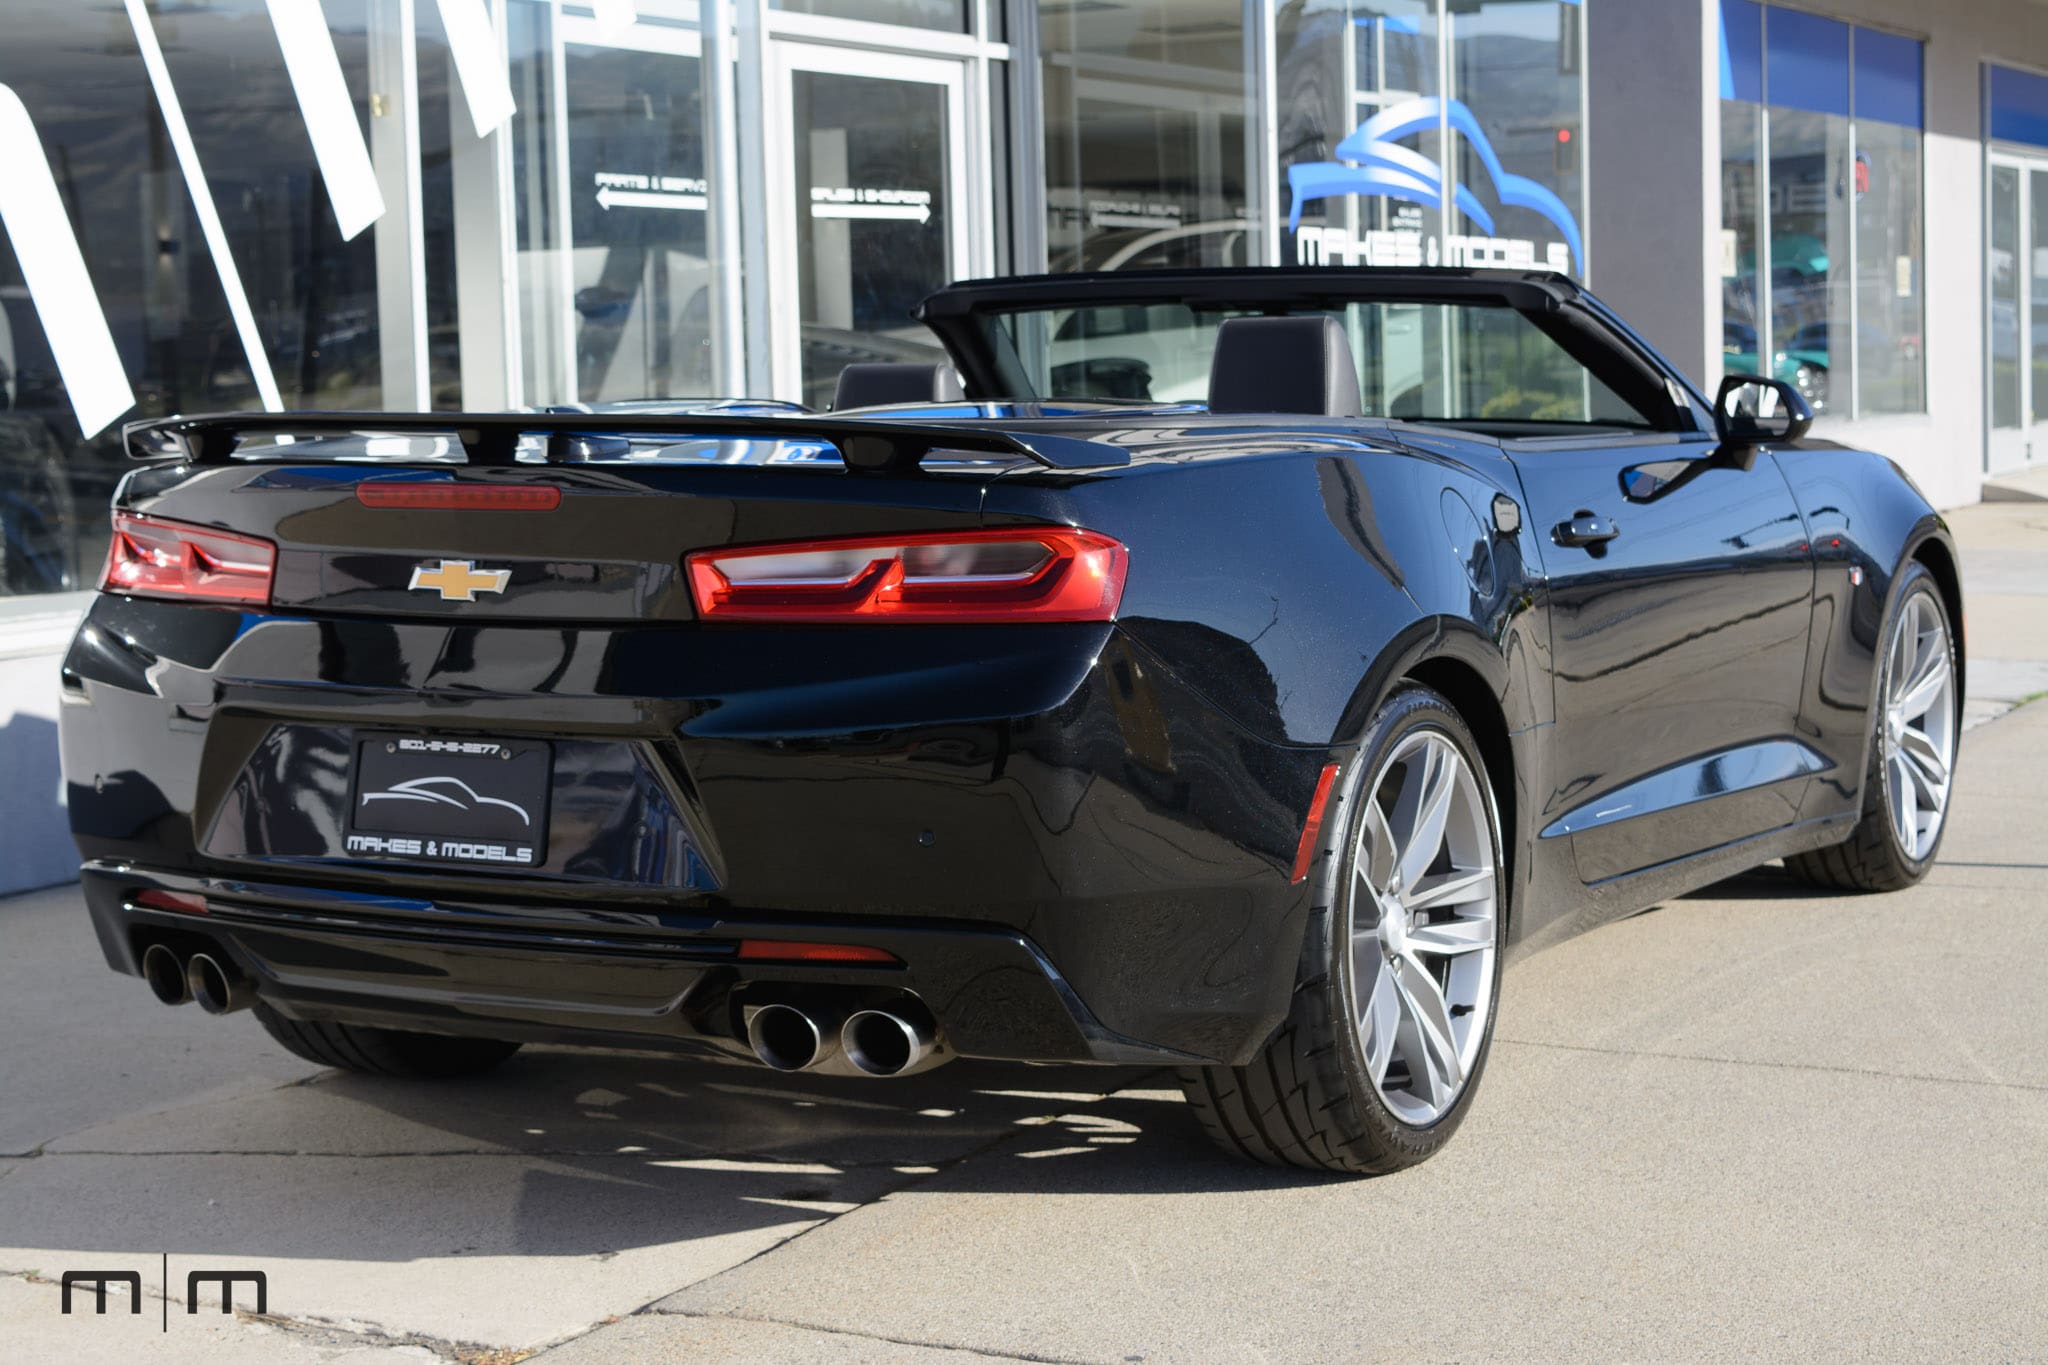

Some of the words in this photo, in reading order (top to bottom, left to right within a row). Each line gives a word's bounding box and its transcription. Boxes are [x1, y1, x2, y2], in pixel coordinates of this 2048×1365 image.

[1297, 226, 1422, 267] MAKES
[1428, 235, 1439, 267] &
[1445, 234, 1569, 275] MODELS
[347, 835, 422, 855] MAKES
[426, 841, 438, 856] &
[441, 842, 533, 863] MODELS
